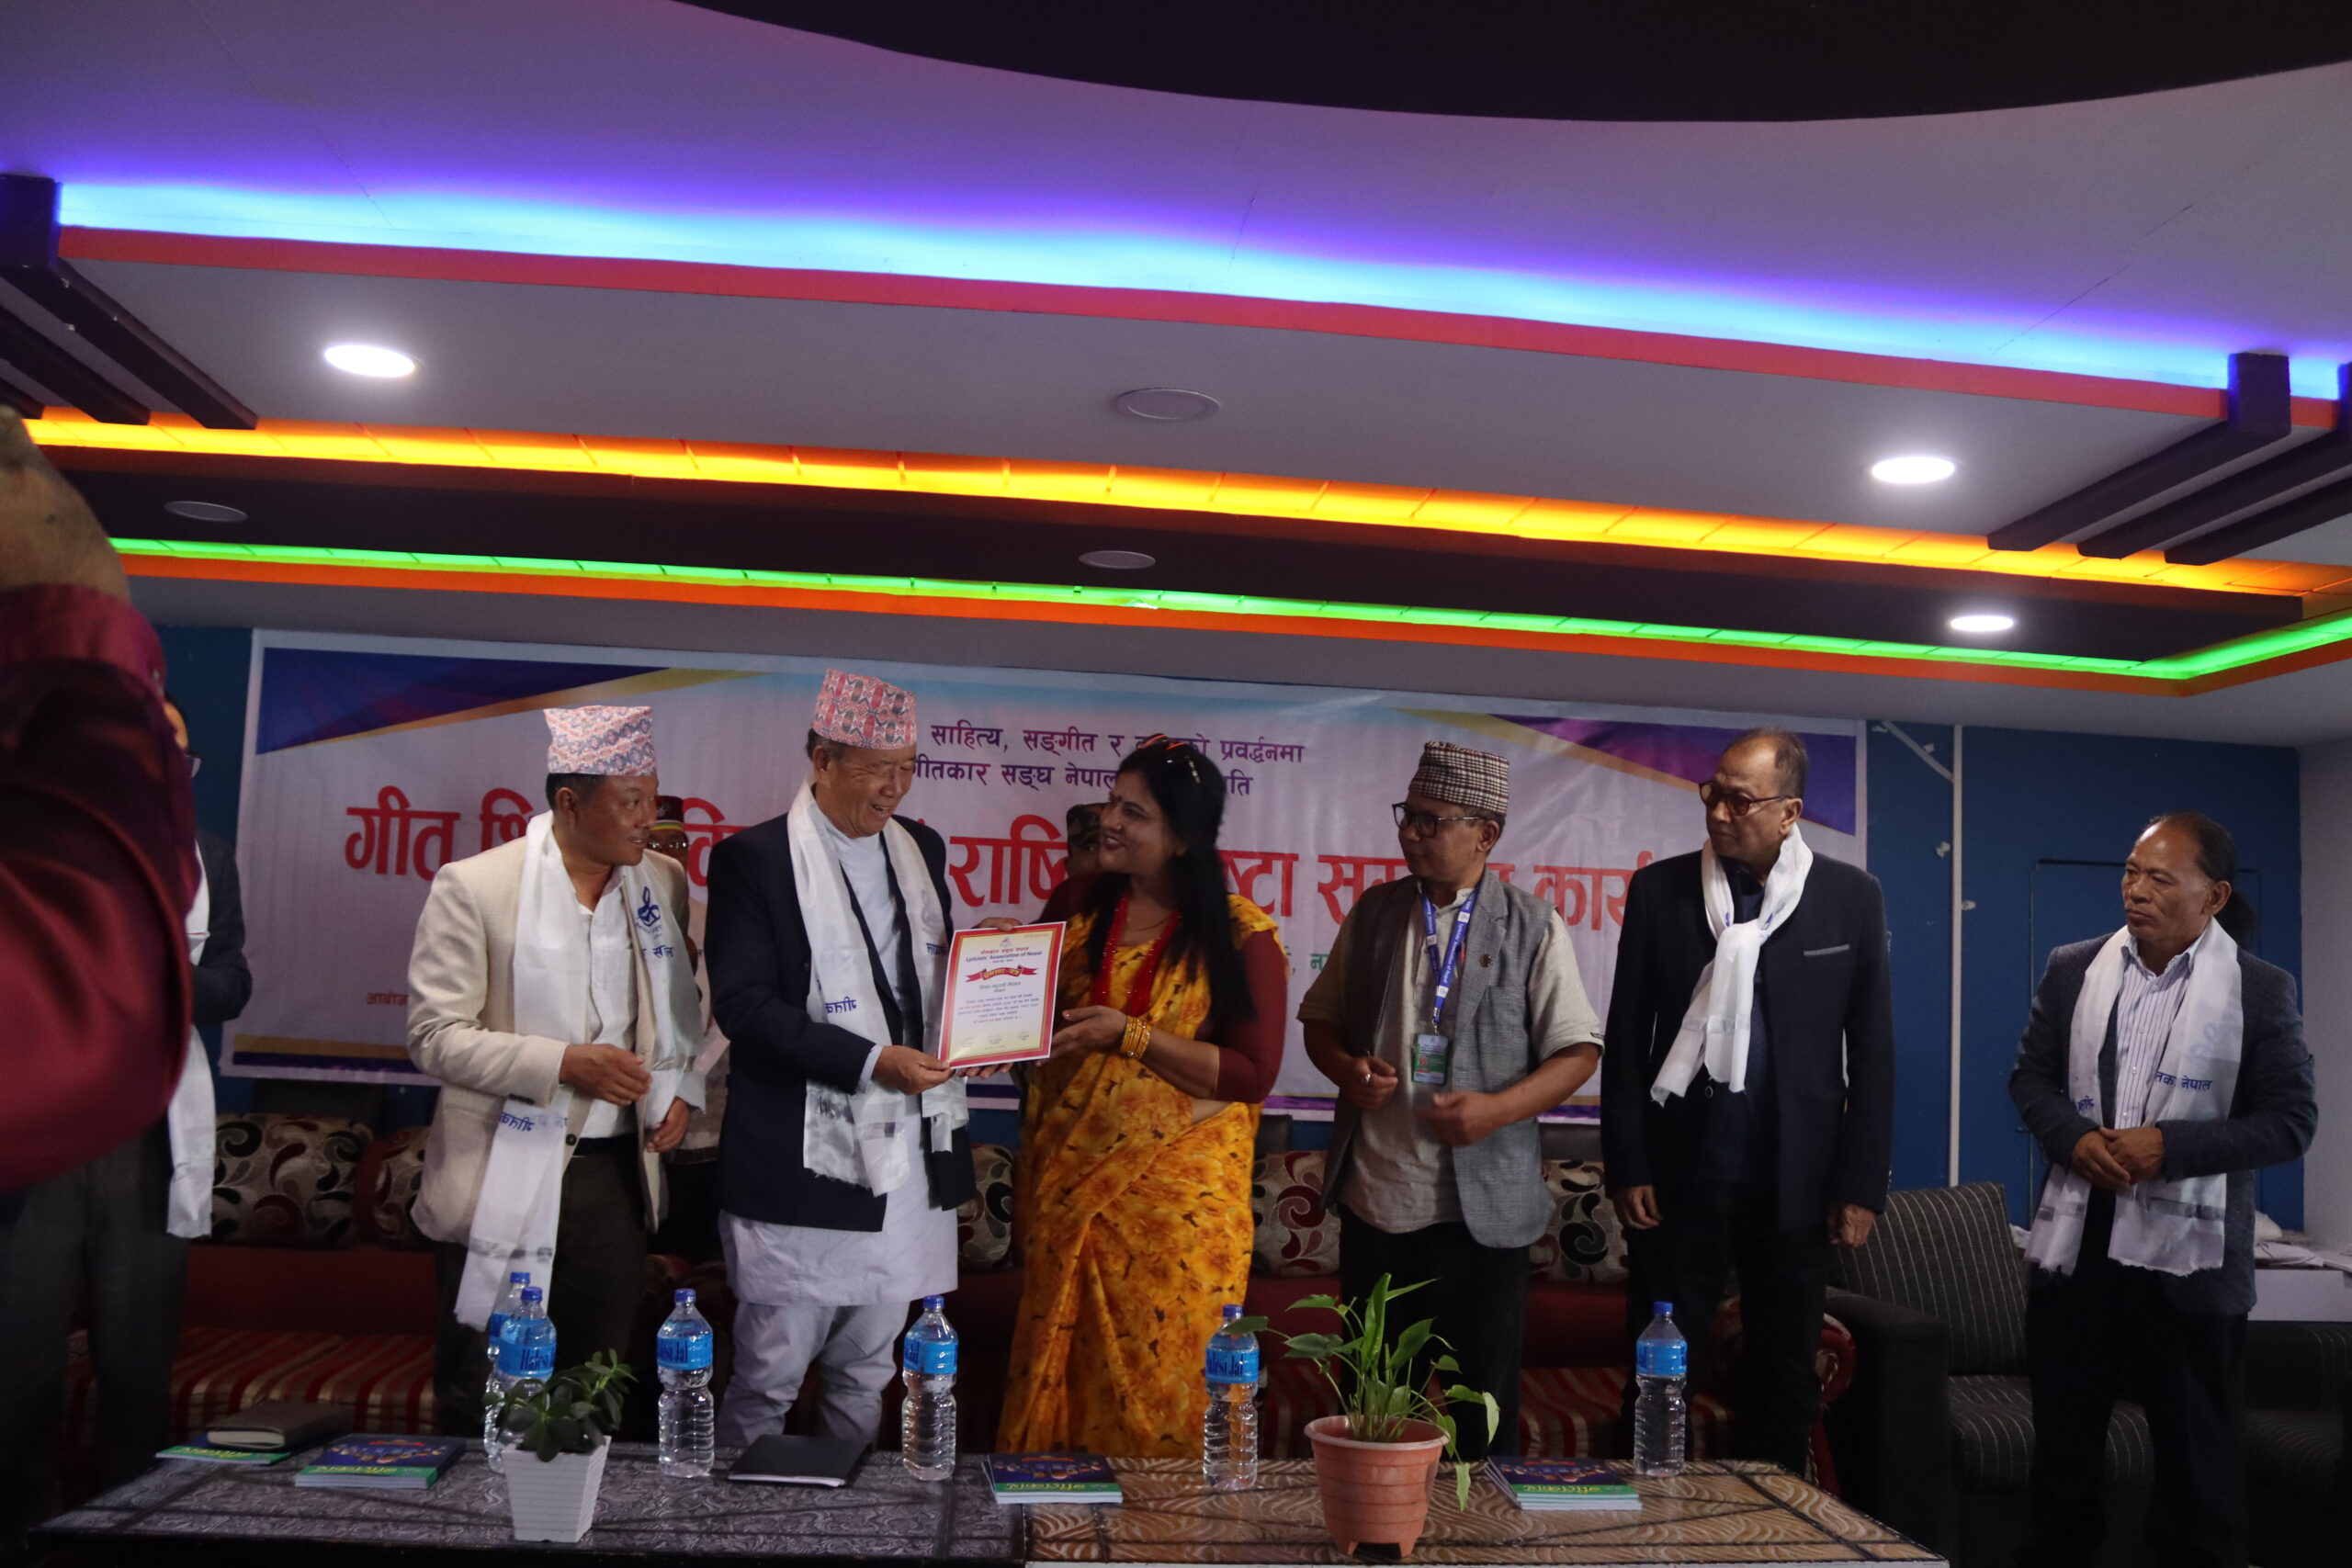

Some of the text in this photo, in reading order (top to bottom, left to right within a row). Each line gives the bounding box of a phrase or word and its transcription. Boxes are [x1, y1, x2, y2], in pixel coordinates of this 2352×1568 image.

[931, 719, 1008, 752] साहित्य,
[1108, 735, 1125, 757] र
[2181, 1075, 2213, 1091] नेपाल
